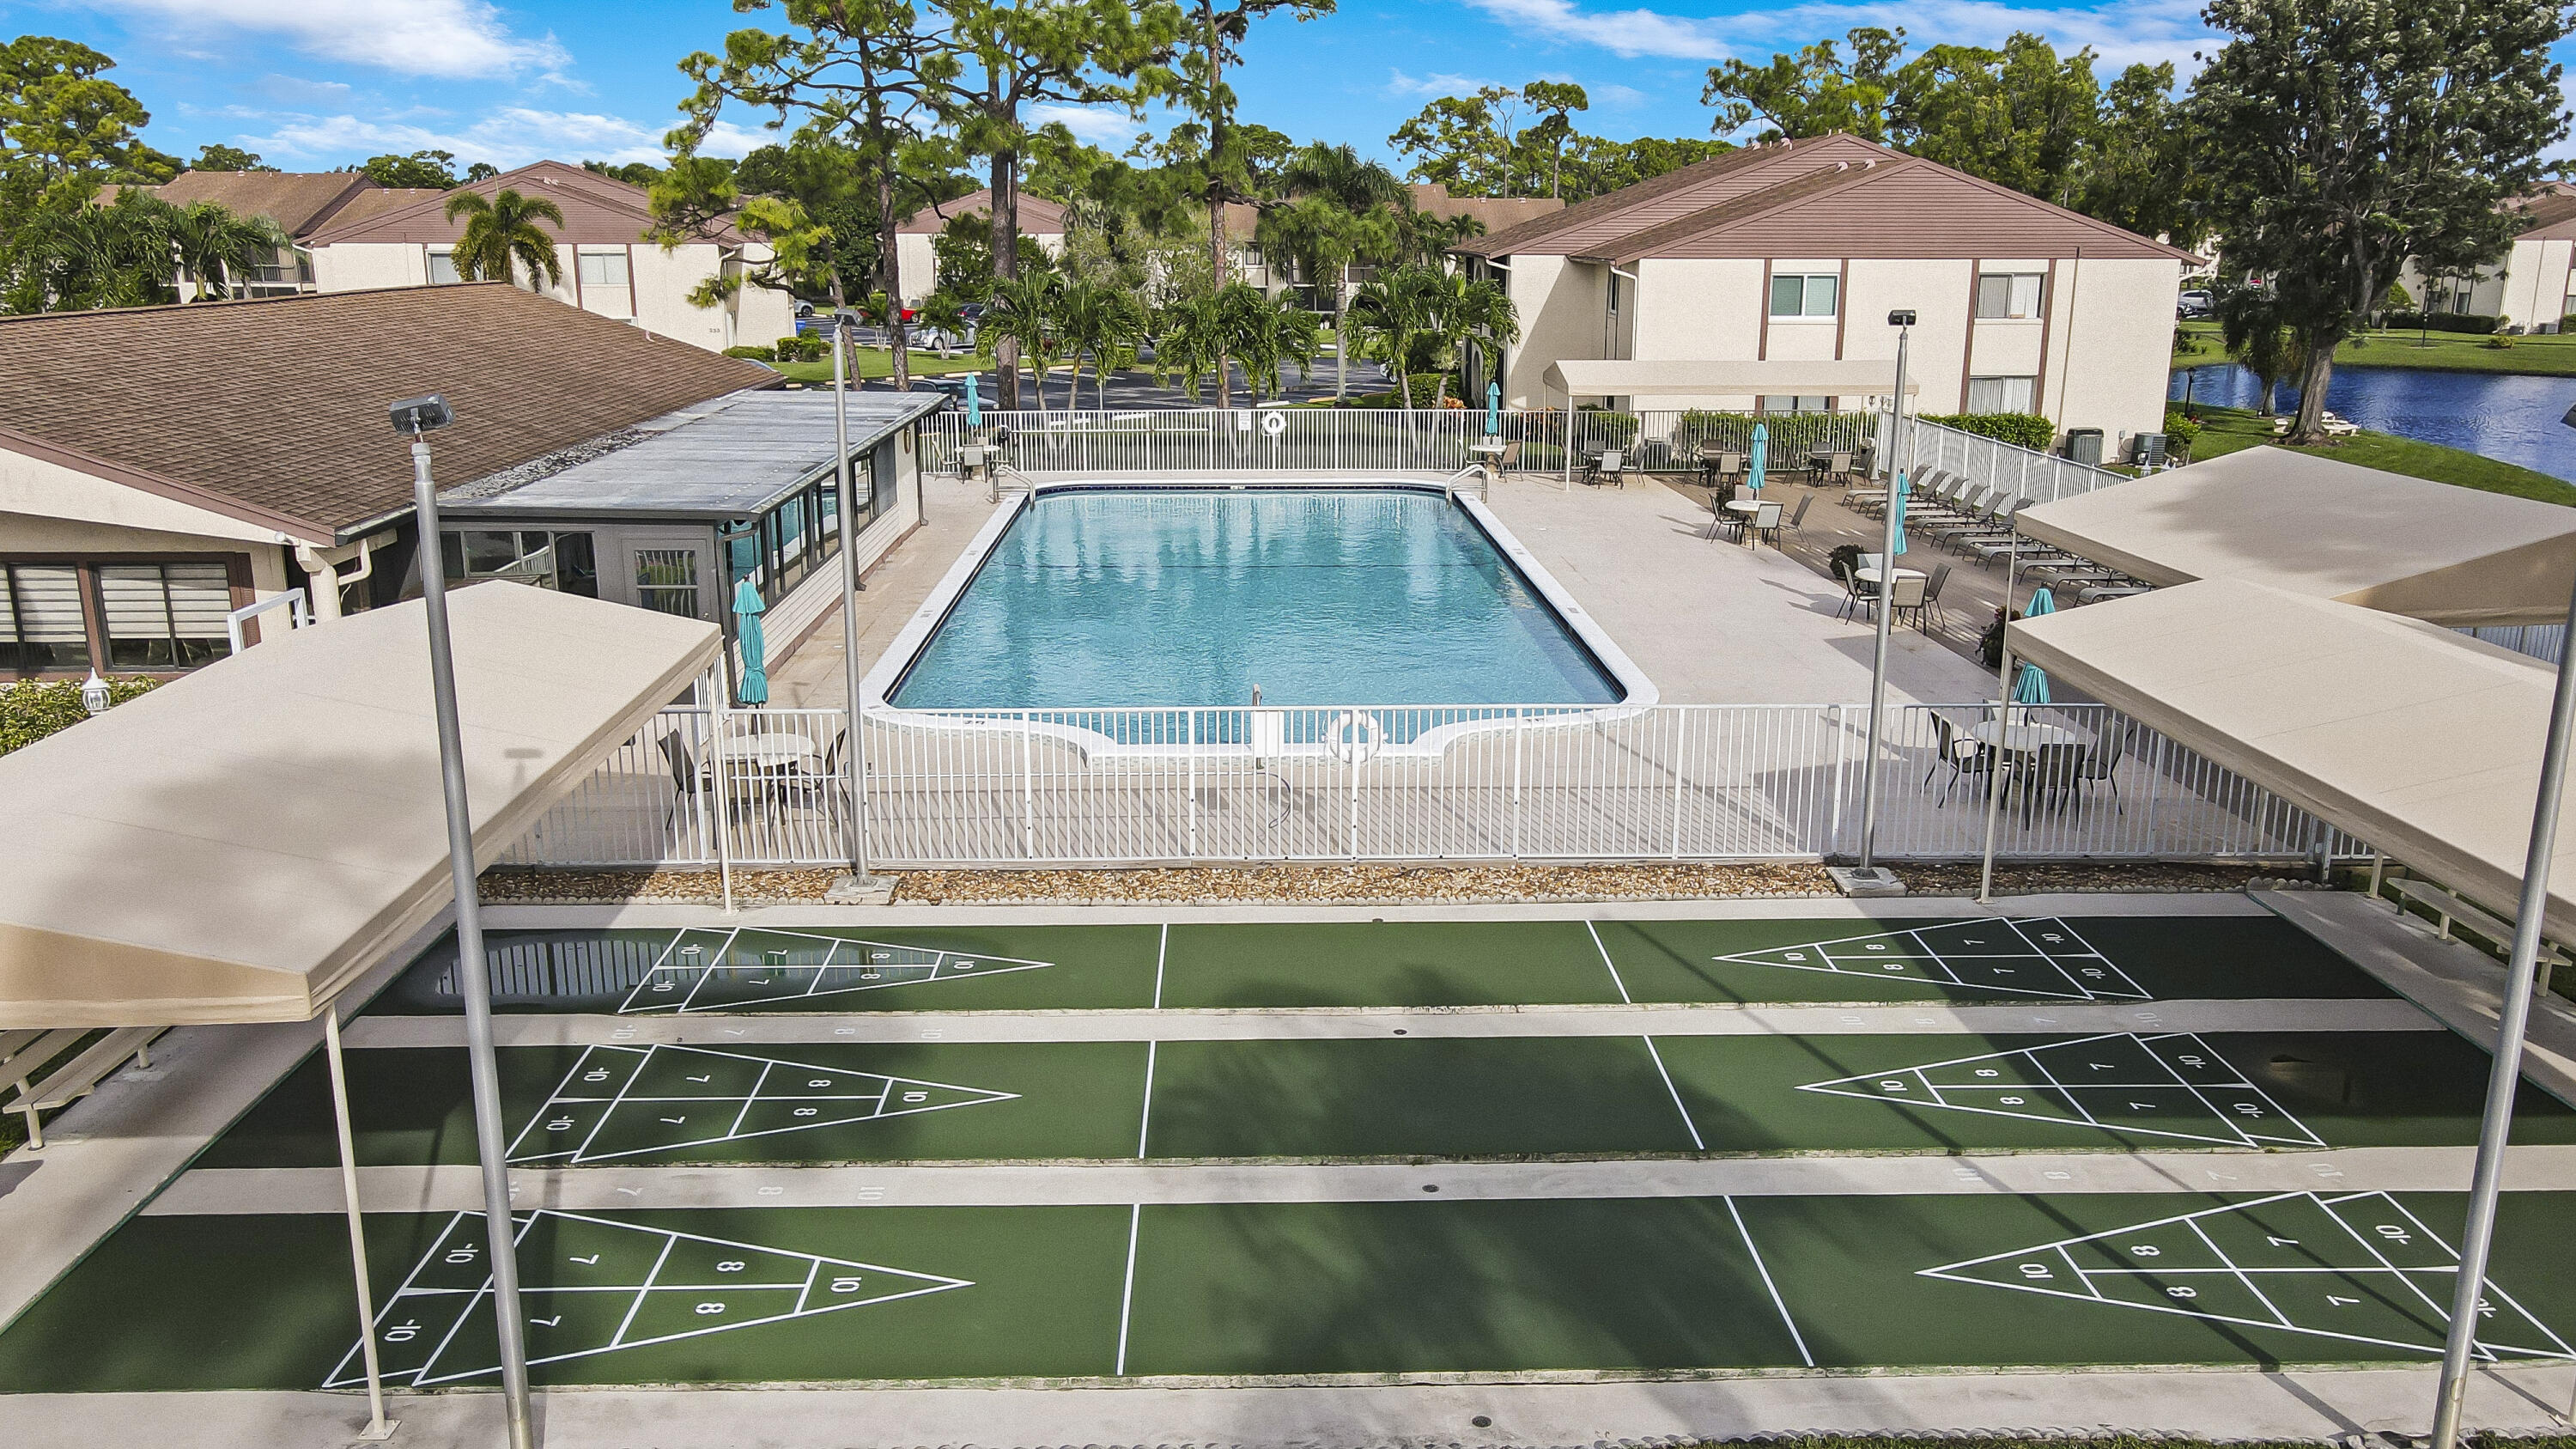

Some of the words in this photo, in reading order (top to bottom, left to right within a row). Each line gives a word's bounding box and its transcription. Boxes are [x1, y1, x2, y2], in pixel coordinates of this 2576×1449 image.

[1783, 953, 1807, 961] 10
[953, 960, 975, 970] 10
[1974, 1068, 1999, 1077] 8
[808, 1079, 832, 1087] 8
[1880, 1080, 1908, 1092] 10
[902, 1091, 928, 1102] 10
[1999, 1096, 2025, 1105] 8
[793, 1107, 818, 1116] 8
[659, 1116, 686, 1124] 7
[2266, 1236, 2300, 1247] 7
[2130, 1245, 2160, 1256] 8
[569, 1254, 599, 1265] 7
[716, 1261, 745, 1272] 8
[2019, 1263, 2054, 1279] 10
[830, 1276, 862, 1293] 10
[2166, 1286, 2196, 1298] 8
[2326, 1294, 2360, 1306] 7
[695, 1302, 726, 1314] 8
[529, 1315, 562, 1327] 7
